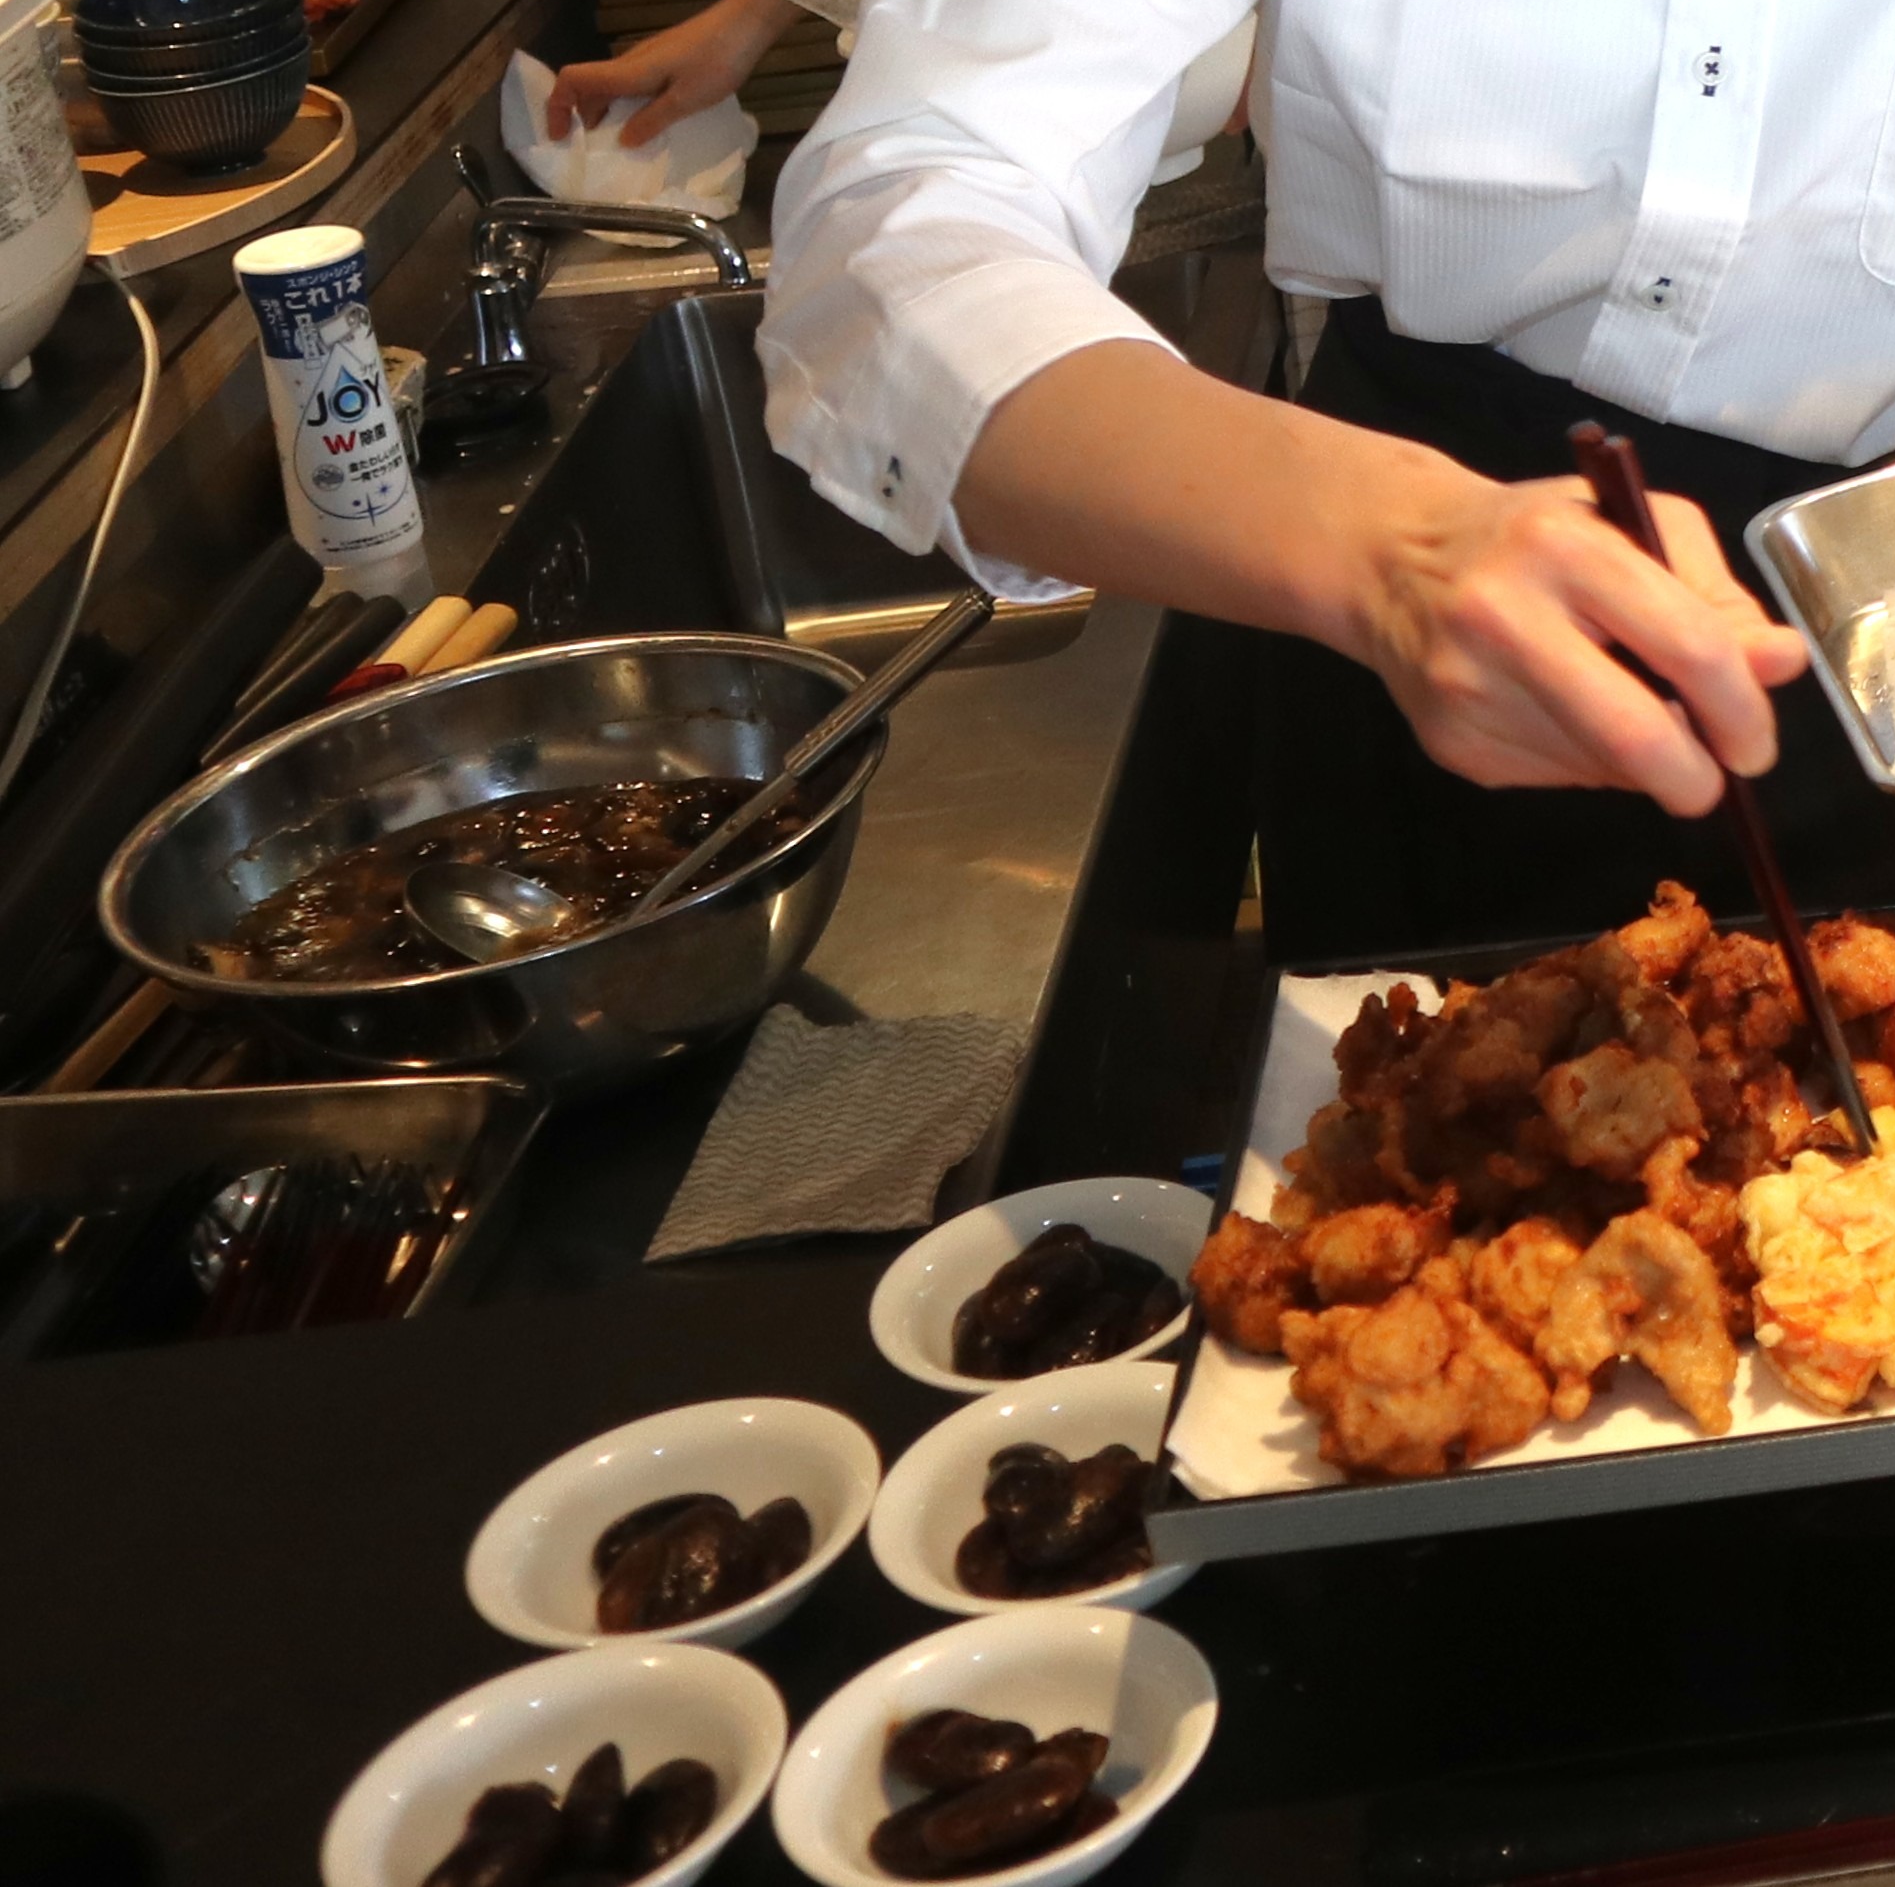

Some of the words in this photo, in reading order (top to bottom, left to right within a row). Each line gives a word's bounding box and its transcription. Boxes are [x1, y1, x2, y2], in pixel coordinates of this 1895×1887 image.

[283, 271, 363, 311] これ1本
[307, 374, 383, 427] JOY
